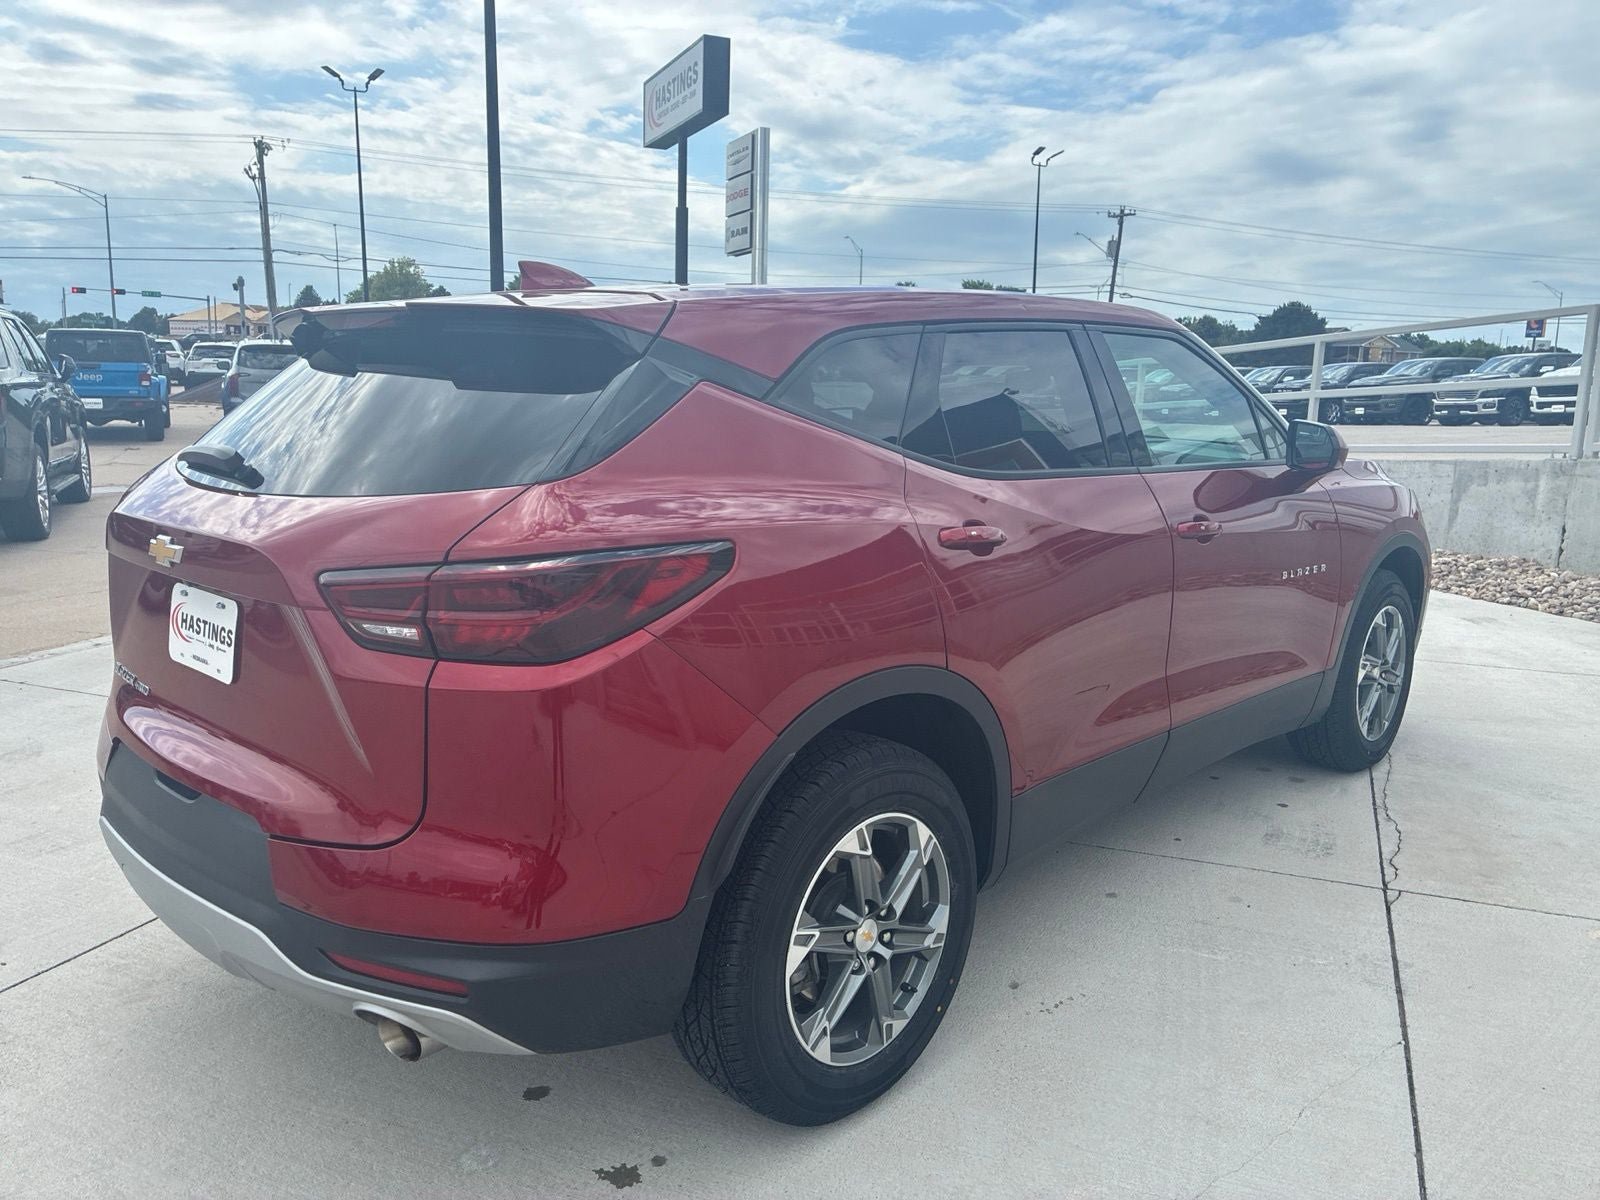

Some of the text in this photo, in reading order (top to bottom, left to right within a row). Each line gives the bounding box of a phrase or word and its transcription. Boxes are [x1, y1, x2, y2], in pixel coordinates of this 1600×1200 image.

[655, 61, 699, 110] HASTINGS
[726, 188, 749, 203] DODGE
[730, 226, 748, 239] RAM
[75, 372, 103, 383] Jeep
[1282, 563, 1327, 580] BLAZER
[180, 611, 234, 648] HASTINGS
